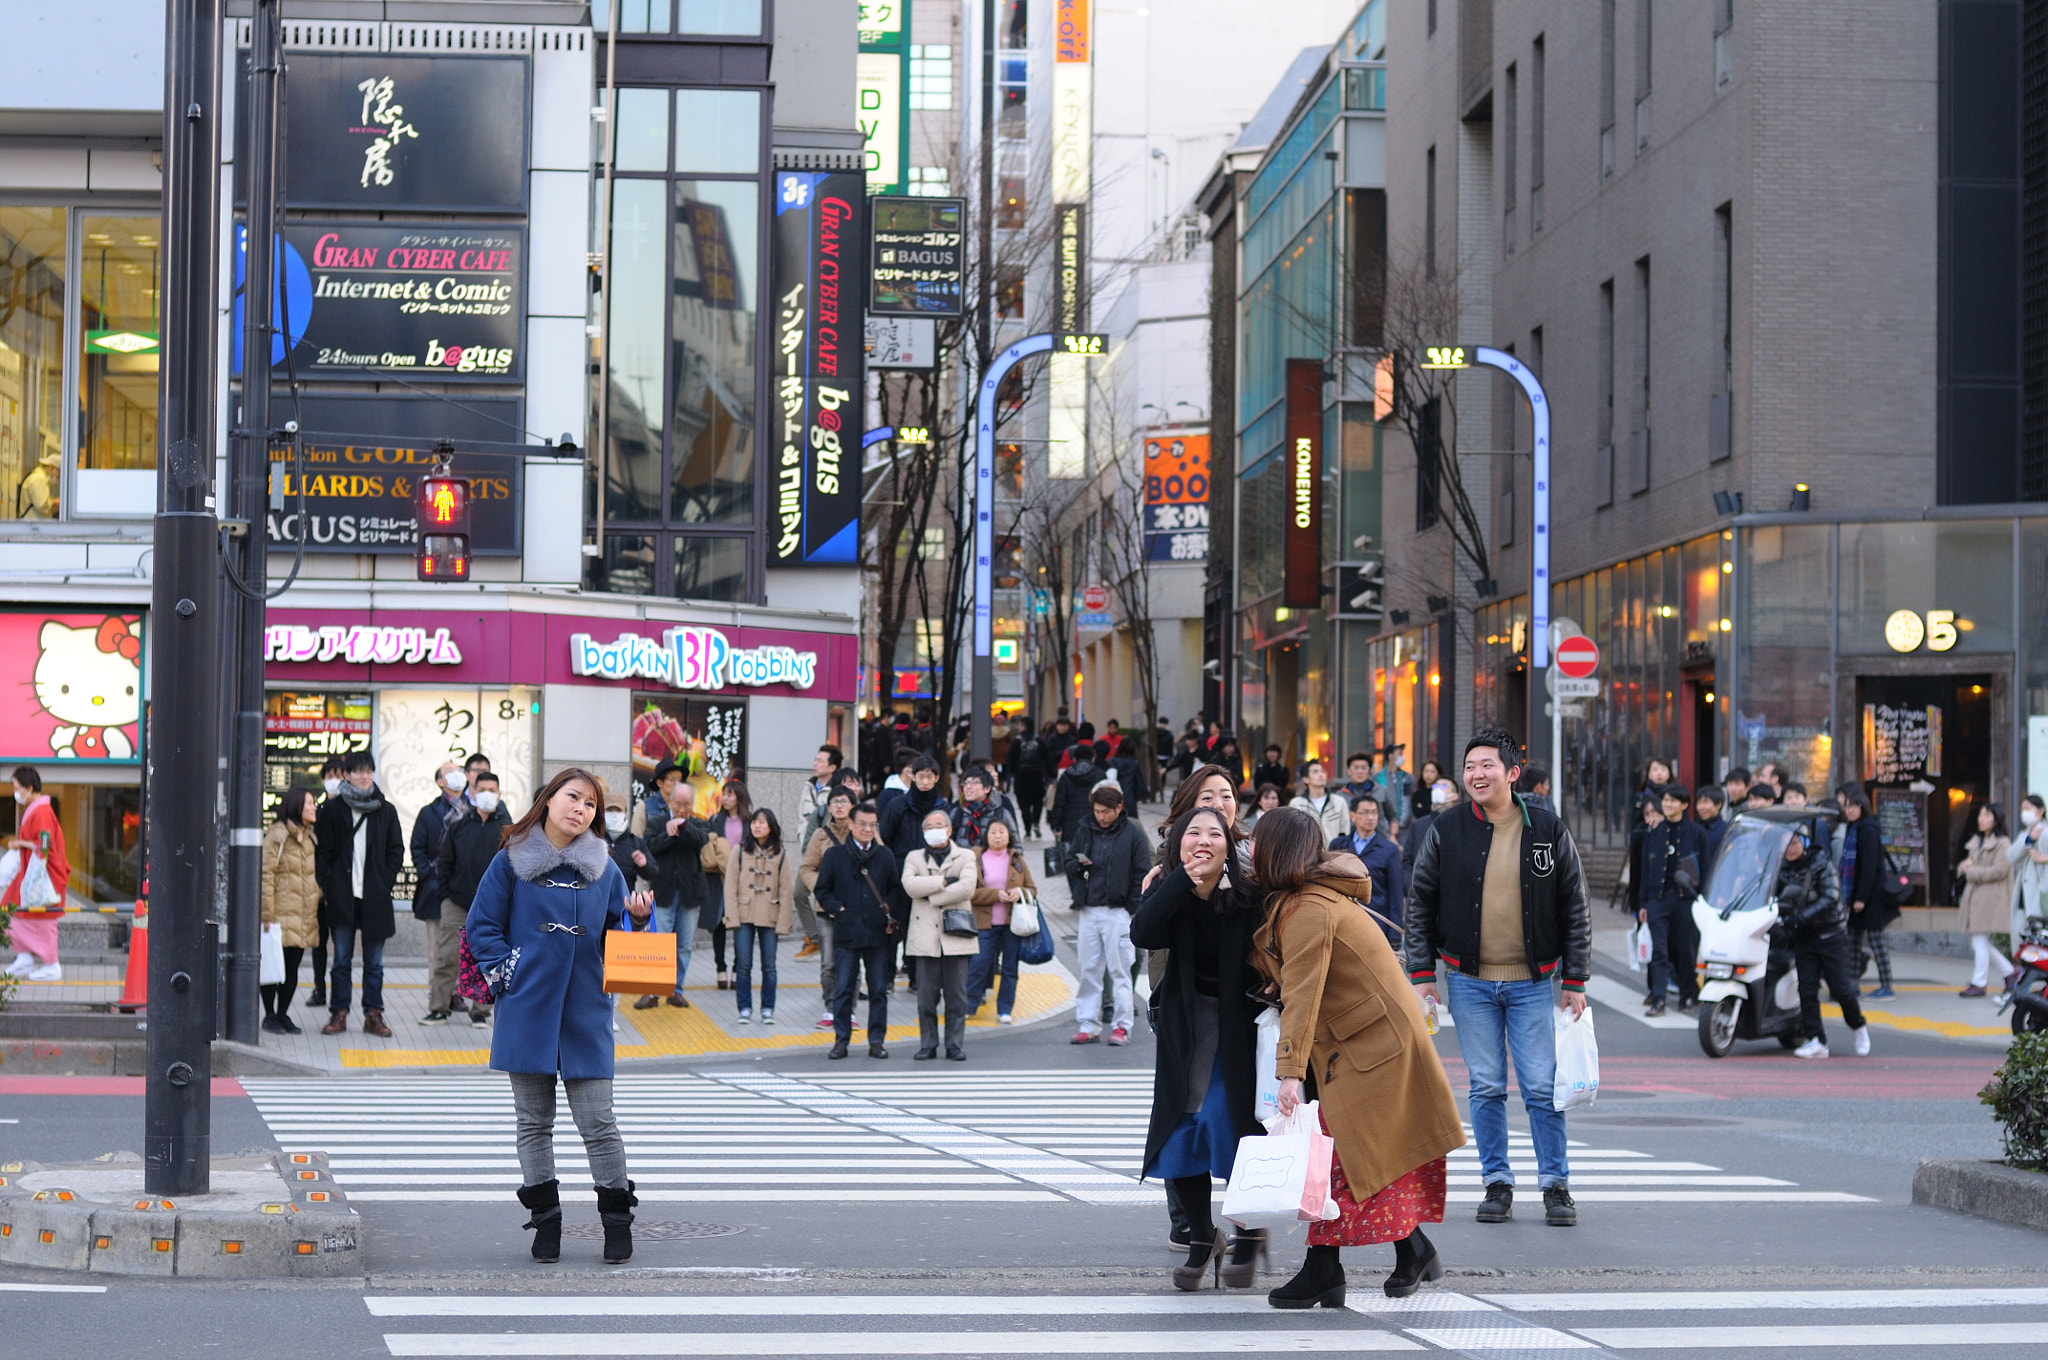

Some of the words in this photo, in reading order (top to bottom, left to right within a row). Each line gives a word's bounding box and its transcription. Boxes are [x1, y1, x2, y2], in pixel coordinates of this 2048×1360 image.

[783, 176, 808, 206] 3F
[819, 196, 853, 258] GRAN
[313, 233, 379, 268] GRAN
[387, 248, 457, 270] CYBER
[459, 249, 513, 271] CAFE
[898, 250, 954, 265] BAGUS
[818, 259, 840, 325] CYBER
[380, 351, 416, 368] Open
[424, 338, 514, 373] b@gus
[817, 326, 838, 377] CAFE
[391, 477, 412, 498] &
[1295, 437, 1312, 529] KOMEHYO
[583, 639, 671, 678] baskin
[732, 651, 813, 685] robbins
[498, 699, 525, 720] 8F
